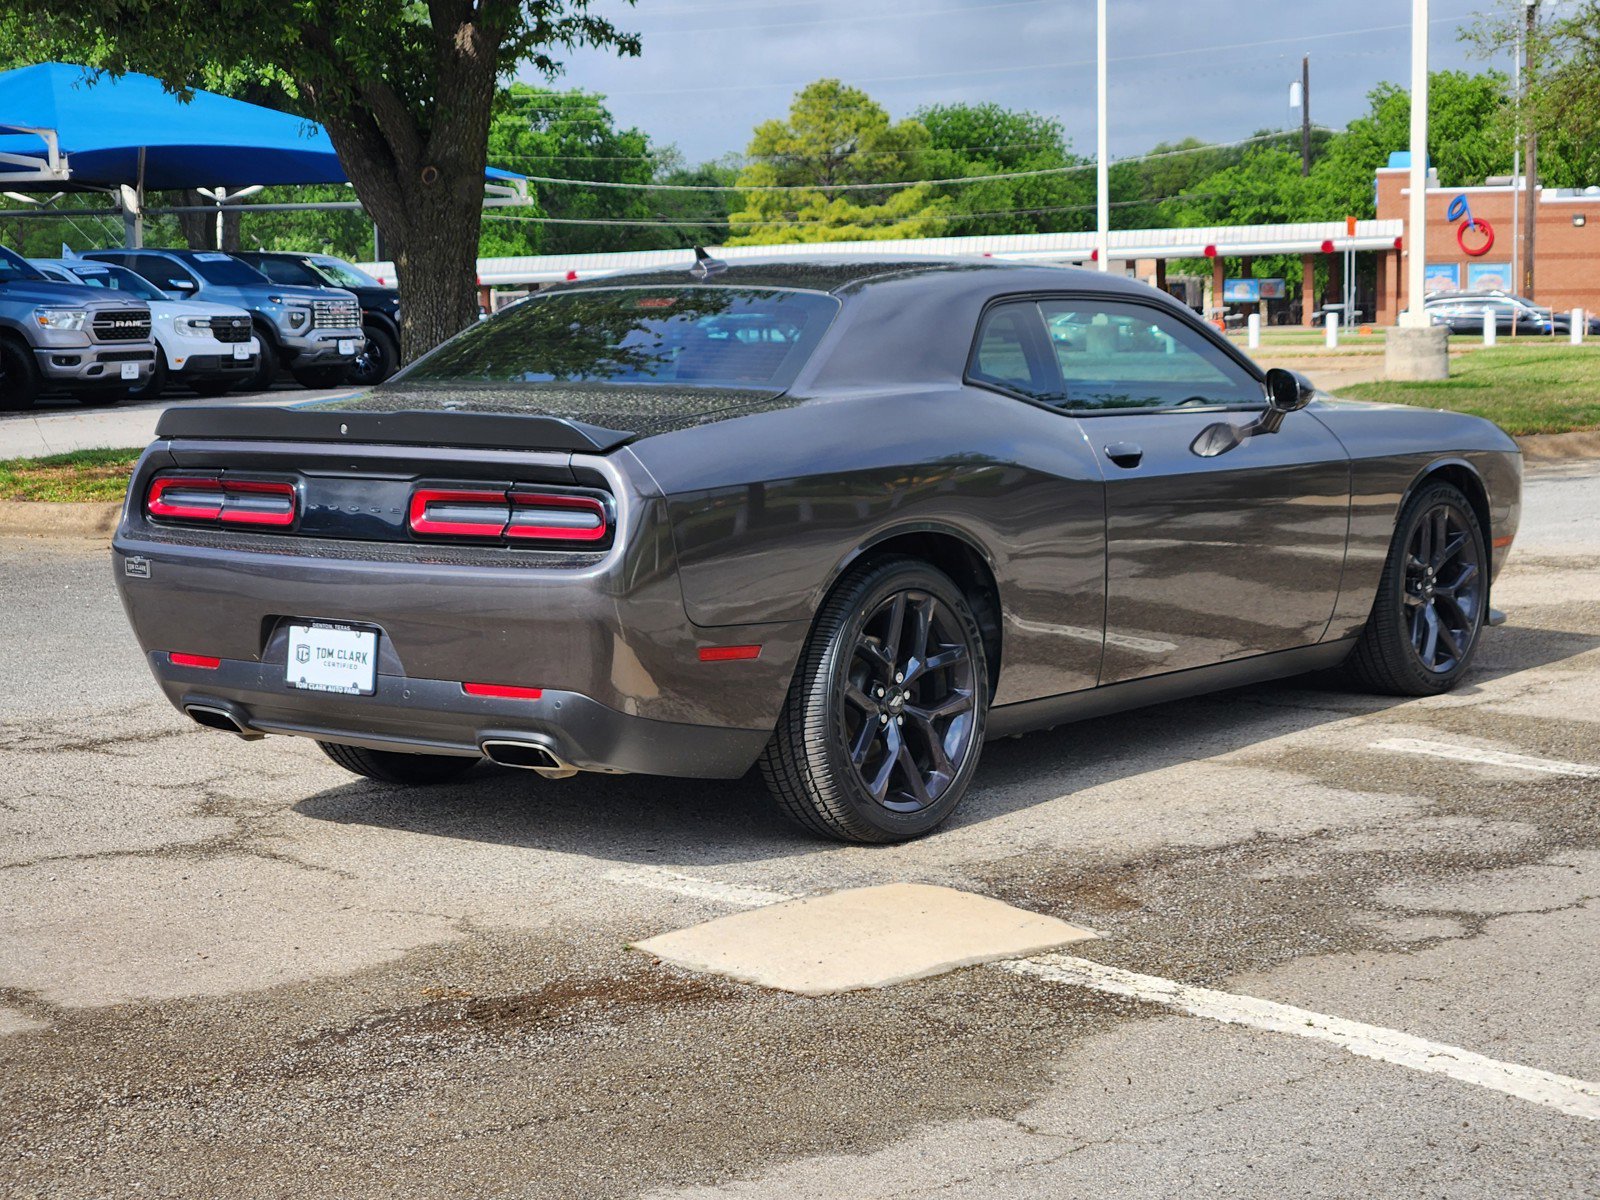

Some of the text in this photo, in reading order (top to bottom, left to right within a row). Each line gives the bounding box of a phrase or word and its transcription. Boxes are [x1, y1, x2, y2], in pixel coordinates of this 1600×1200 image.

[115, 320, 141, 328] RAM
[307, 503, 401, 514] DODGE
[316, 647, 368, 665] TOM CLARK
[323, 660, 358, 670] CERTIFIED
